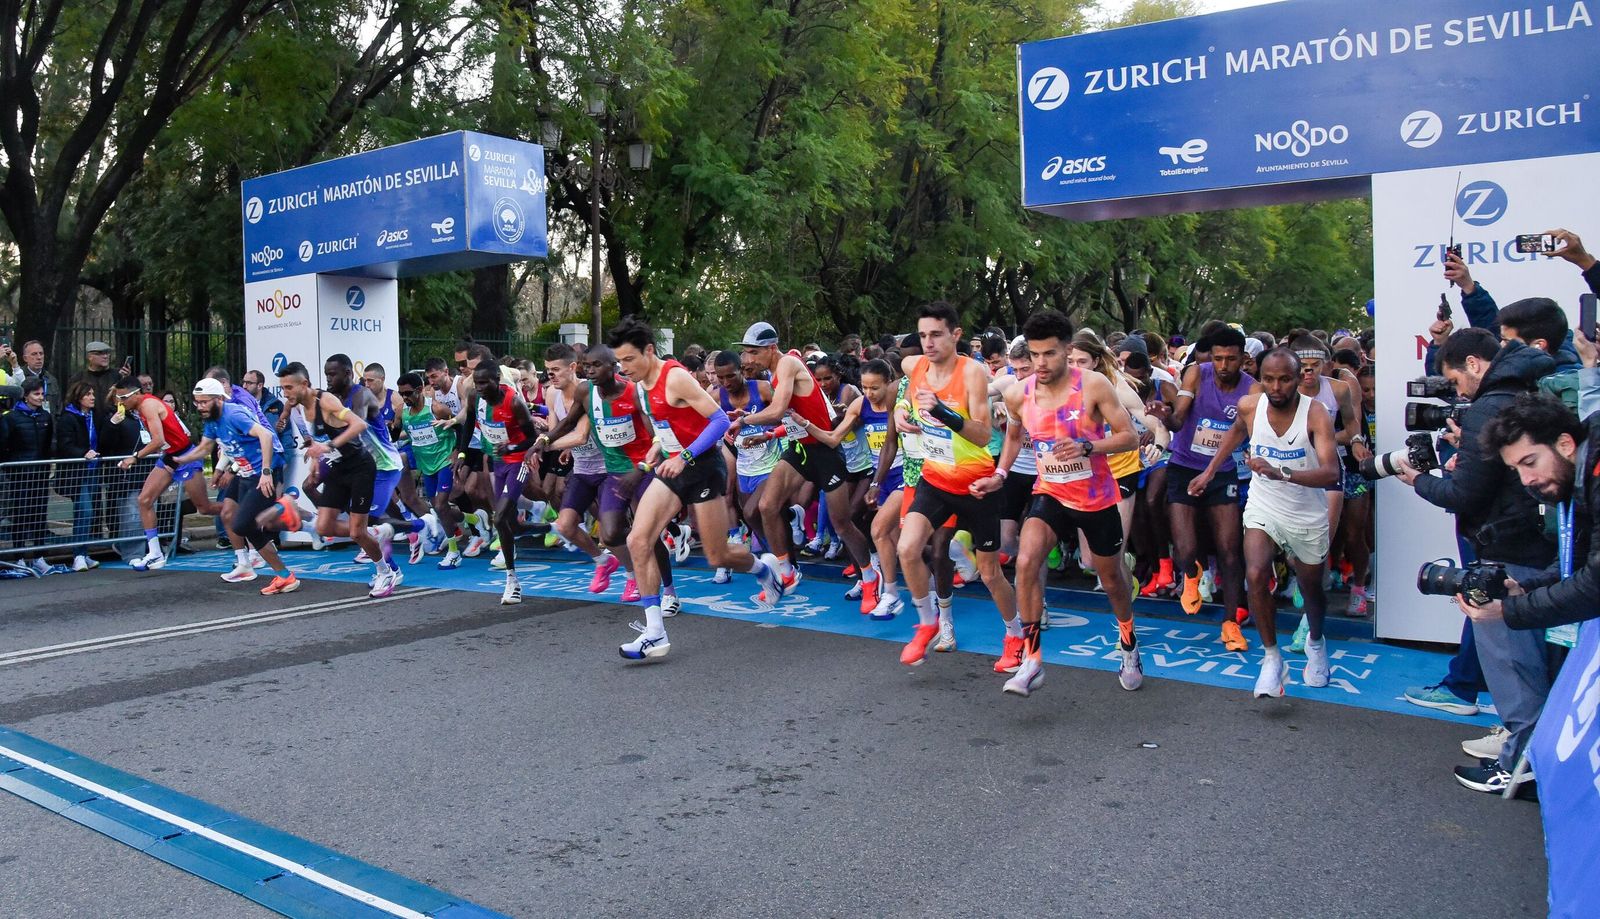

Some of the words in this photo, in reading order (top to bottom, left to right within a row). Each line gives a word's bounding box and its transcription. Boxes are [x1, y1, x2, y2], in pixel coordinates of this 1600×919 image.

[1083, 55, 1207, 96] ZURICH
[1225, 28, 1378, 76] MARATÓN
[1389, 23, 1433, 54] DE
[1443, 0, 1593, 47] SEVILLA
[1457, 102, 1581, 135] ZURICH
[484, 150, 515, 164] ZURICH
[483, 164, 517, 178] MARATÓN
[1159, 165, 1209, 177] TotalEnergies
[268, 190, 318, 214] ZURICH
[324, 175, 382, 203] MARATÓN
[386, 172, 402, 191] DE
[405, 160, 459, 186] SEVILLA
[483, 174, 517, 189] SEVILLA
[317, 237, 357, 255] ZURICH
[1413, 240, 1554, 268] ZRIC
[330, 317, 382, 332] ZURICH
[605, 432, 628, 440] PACER
[1272, 450, 1299, 460] ZURICH
[1044, 461, 1084, 474] KHADIRI
